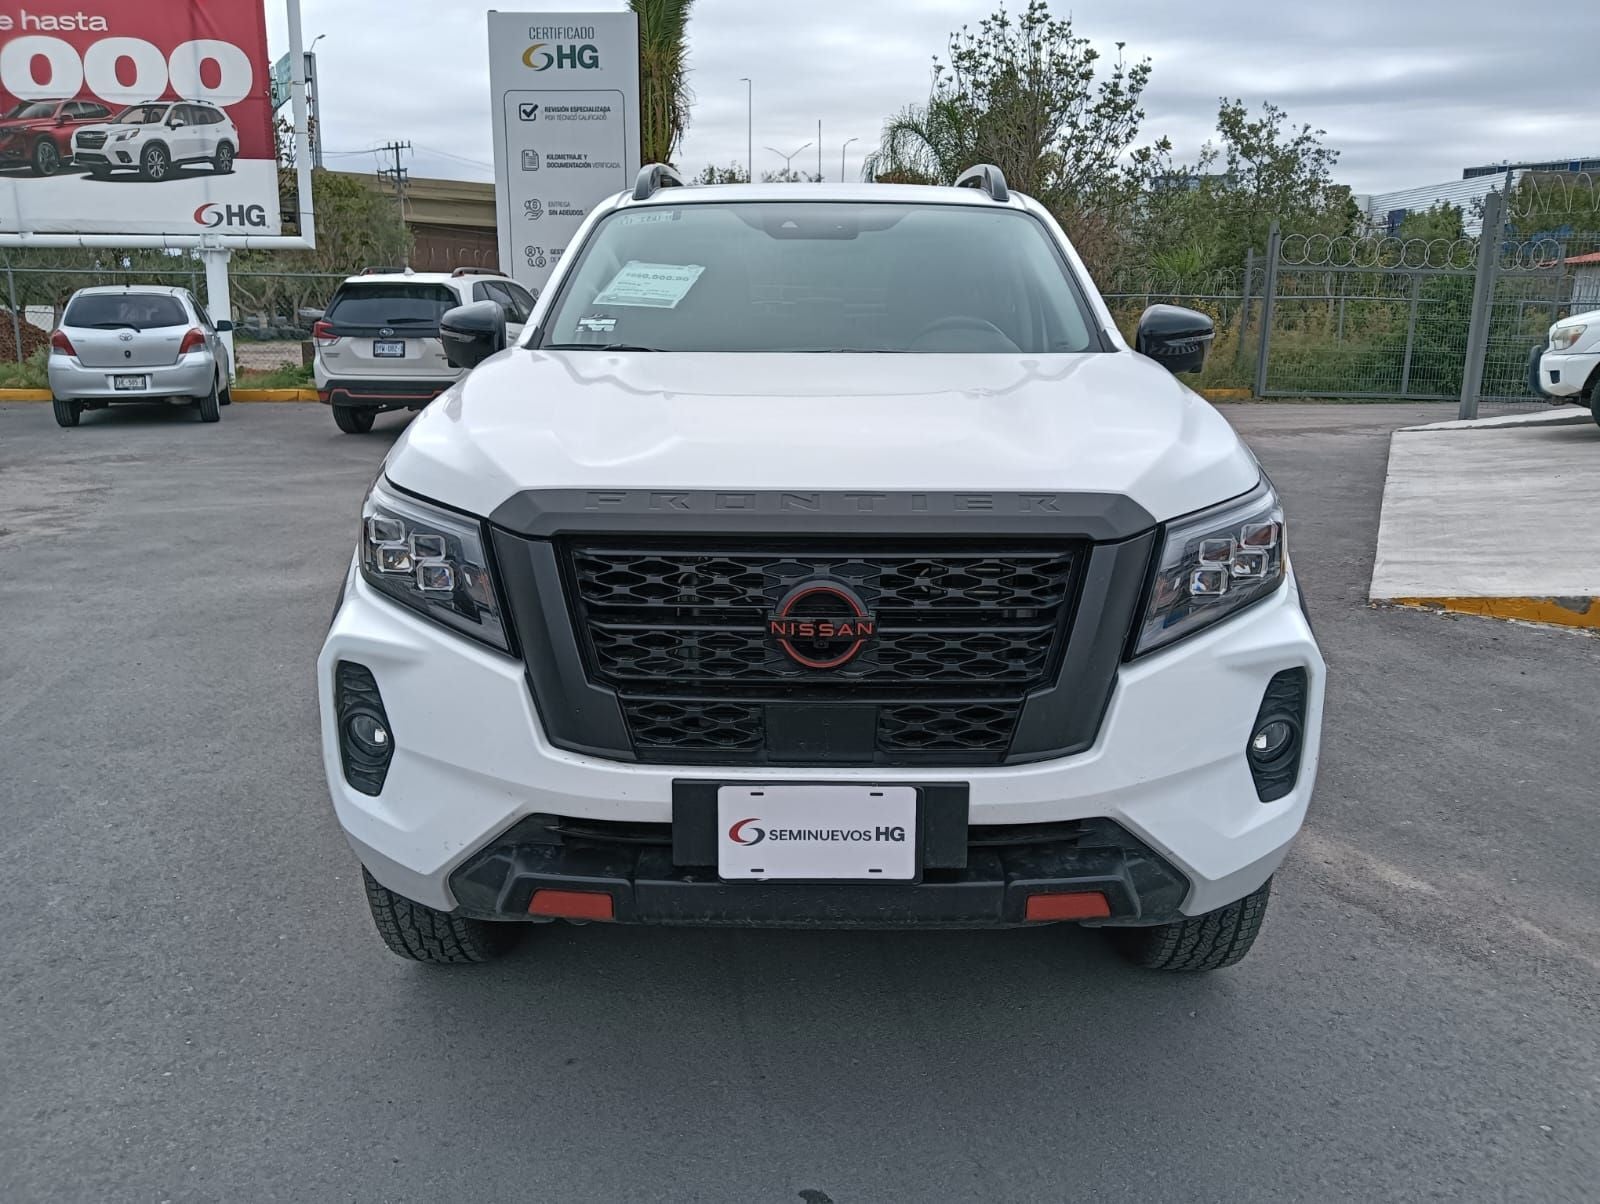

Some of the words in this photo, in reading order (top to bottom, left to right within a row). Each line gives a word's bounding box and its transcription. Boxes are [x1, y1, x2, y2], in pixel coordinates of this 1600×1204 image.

[20, 9, 109, 31] hasta
[528, 26, 595, 40] CERTIFICADO
[556, 44, 599, 69] HG
[226, 204, 266, 227] HG
[583, 491, 1062, 512] FRONTIER
[771, 621, 873, 637] NISSAN
[768, 829, 872, 842] SEMINUEVOS
[874, 826, 905, 842] HG
